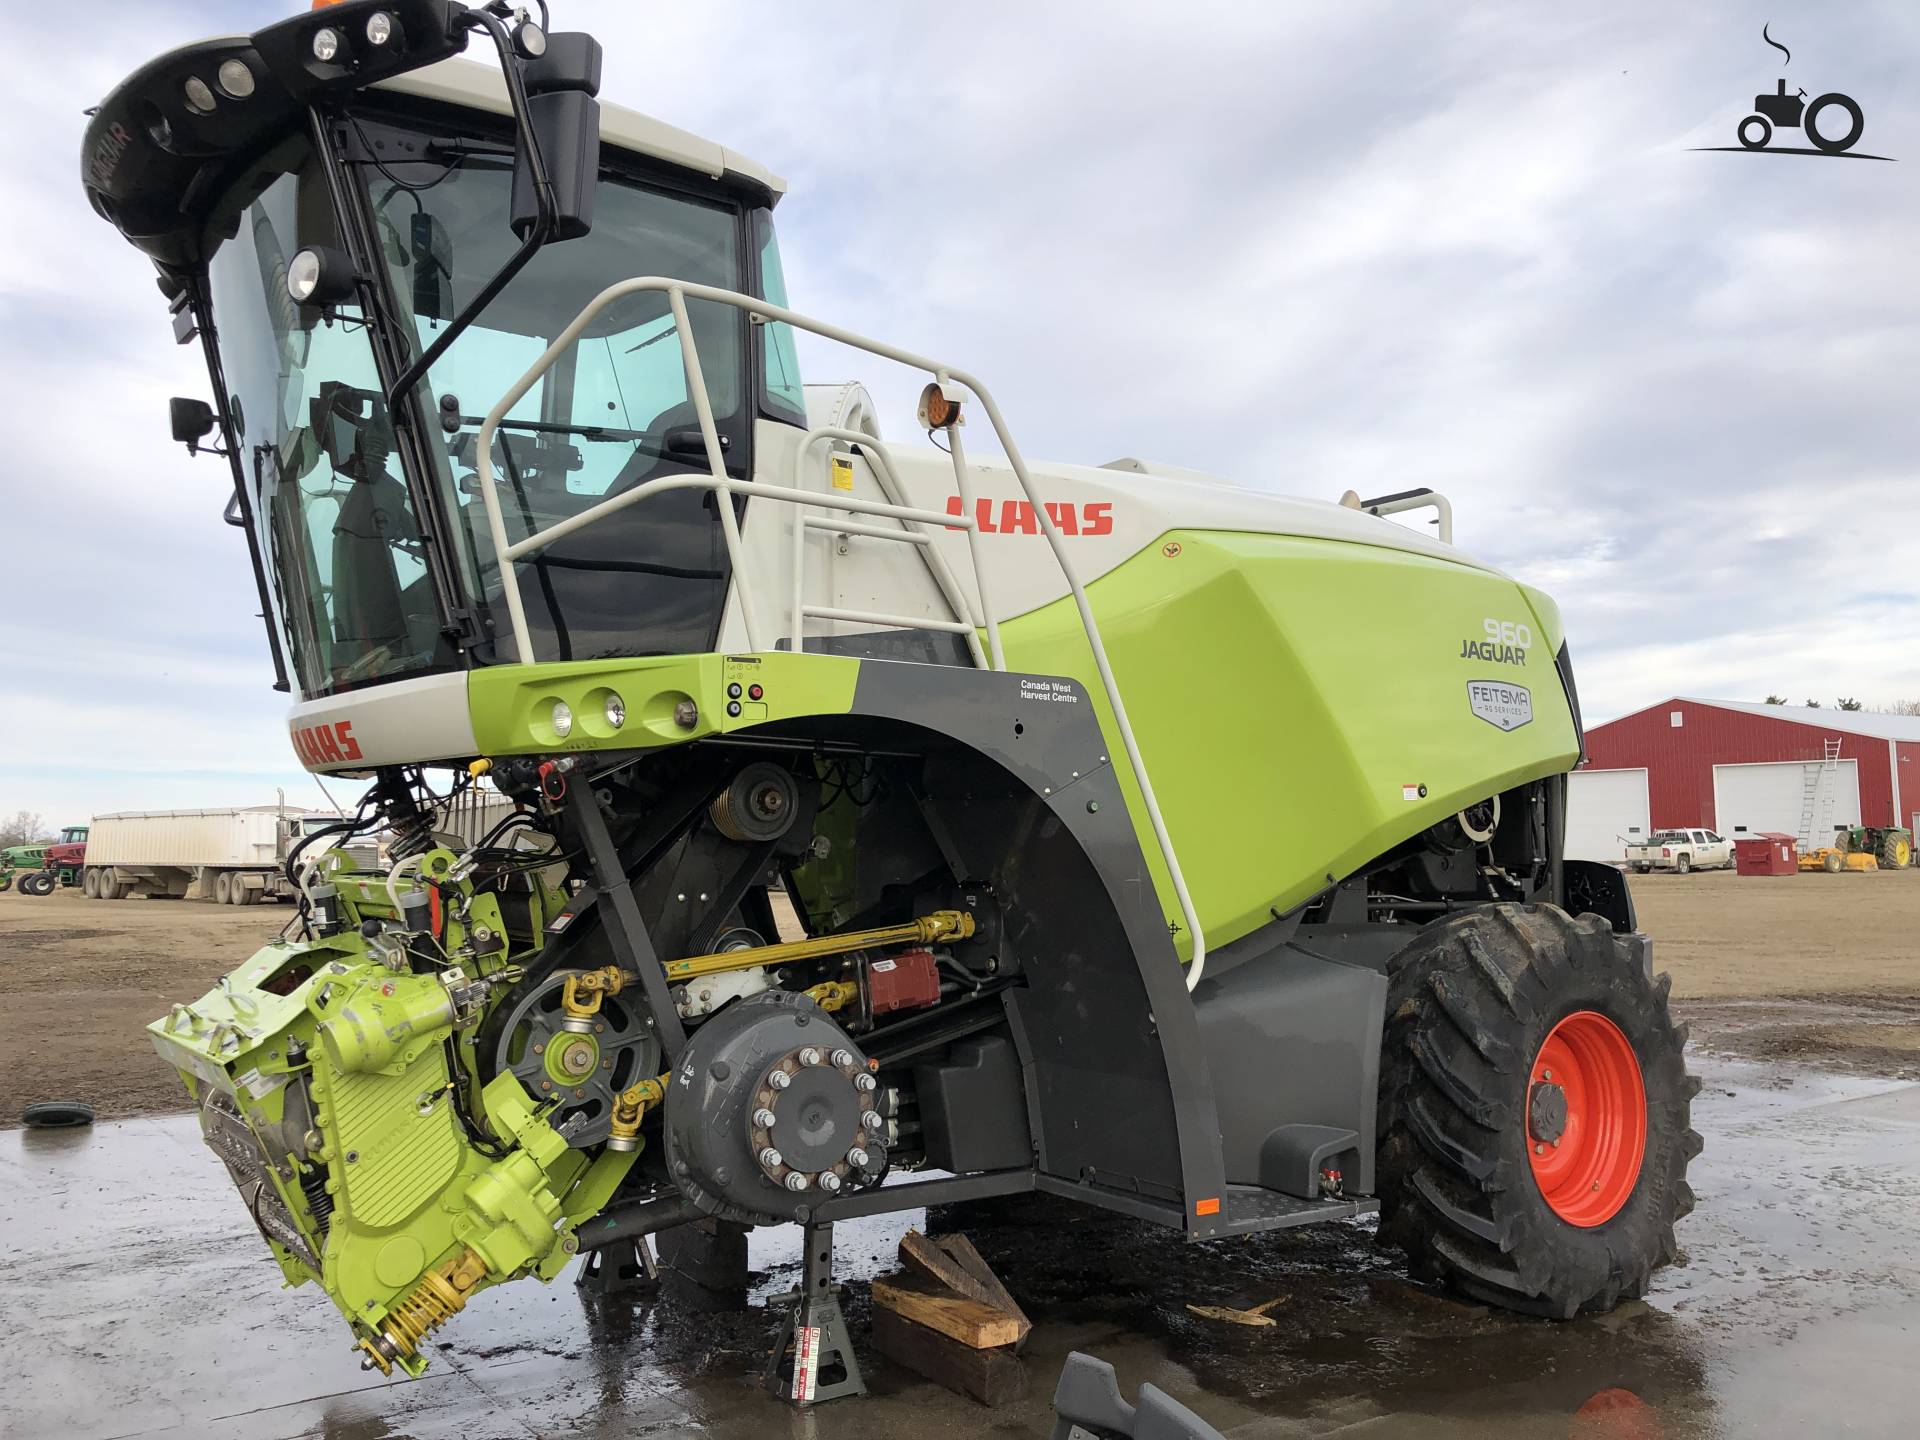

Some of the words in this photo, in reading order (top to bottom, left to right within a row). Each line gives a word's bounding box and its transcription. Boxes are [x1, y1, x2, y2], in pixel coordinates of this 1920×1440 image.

[1483, 618, 1532, 648] 960
[1460, 639, 1526, 666] JAGUAR
[1020, 680, 1050, 691] Canada
[1052, 682, 1071, 693] West
[1020, 690, 1051, 701] Harvest
[1052, 692, 1078, 703] Centre
[1472, 686, 1529, 706] FEITSMA
